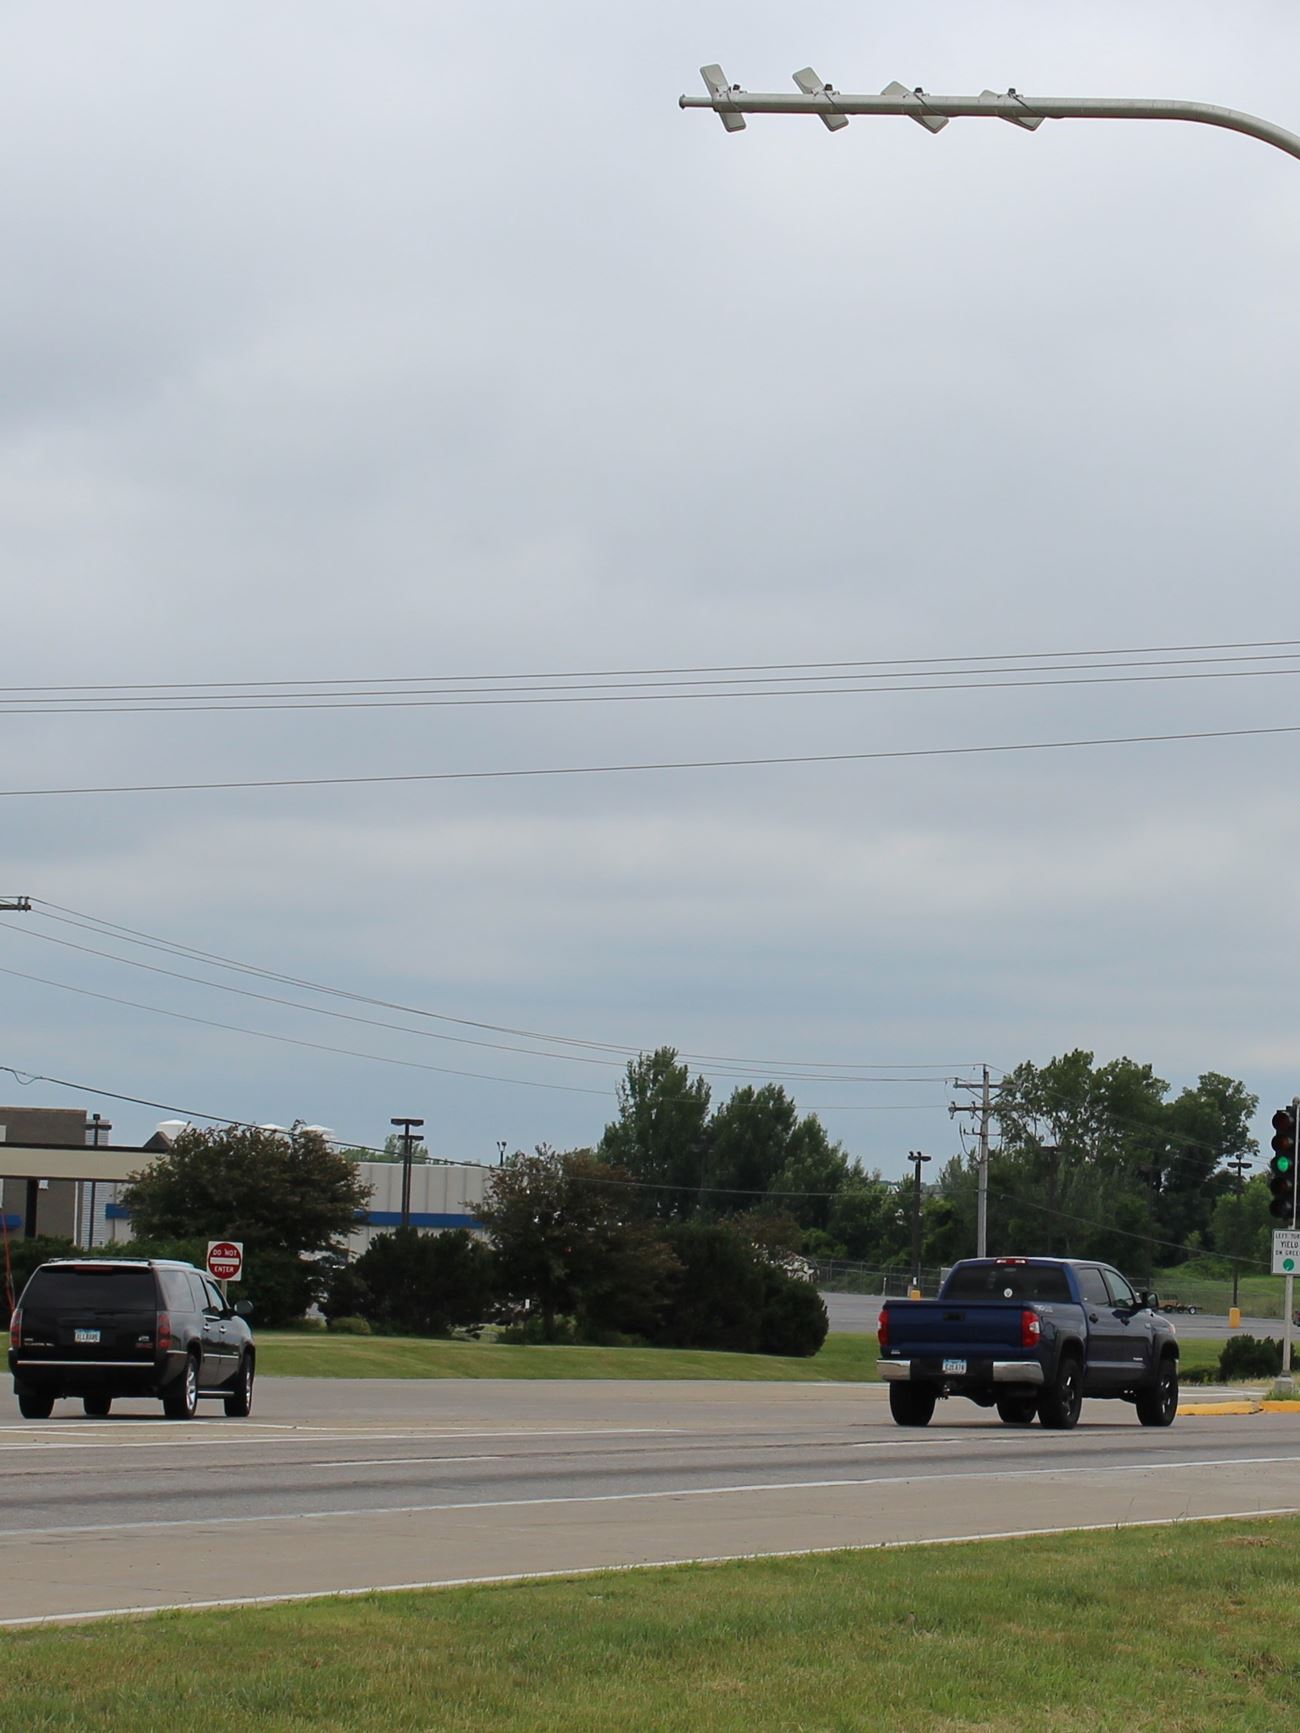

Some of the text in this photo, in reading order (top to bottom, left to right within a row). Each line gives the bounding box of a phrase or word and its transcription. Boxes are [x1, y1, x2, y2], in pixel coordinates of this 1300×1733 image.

[1280, 1241, 1299, 1249] YIELD
[224, 1248, 237, 1257] NOT
[214, 1265, 234, 1273] ENTER
